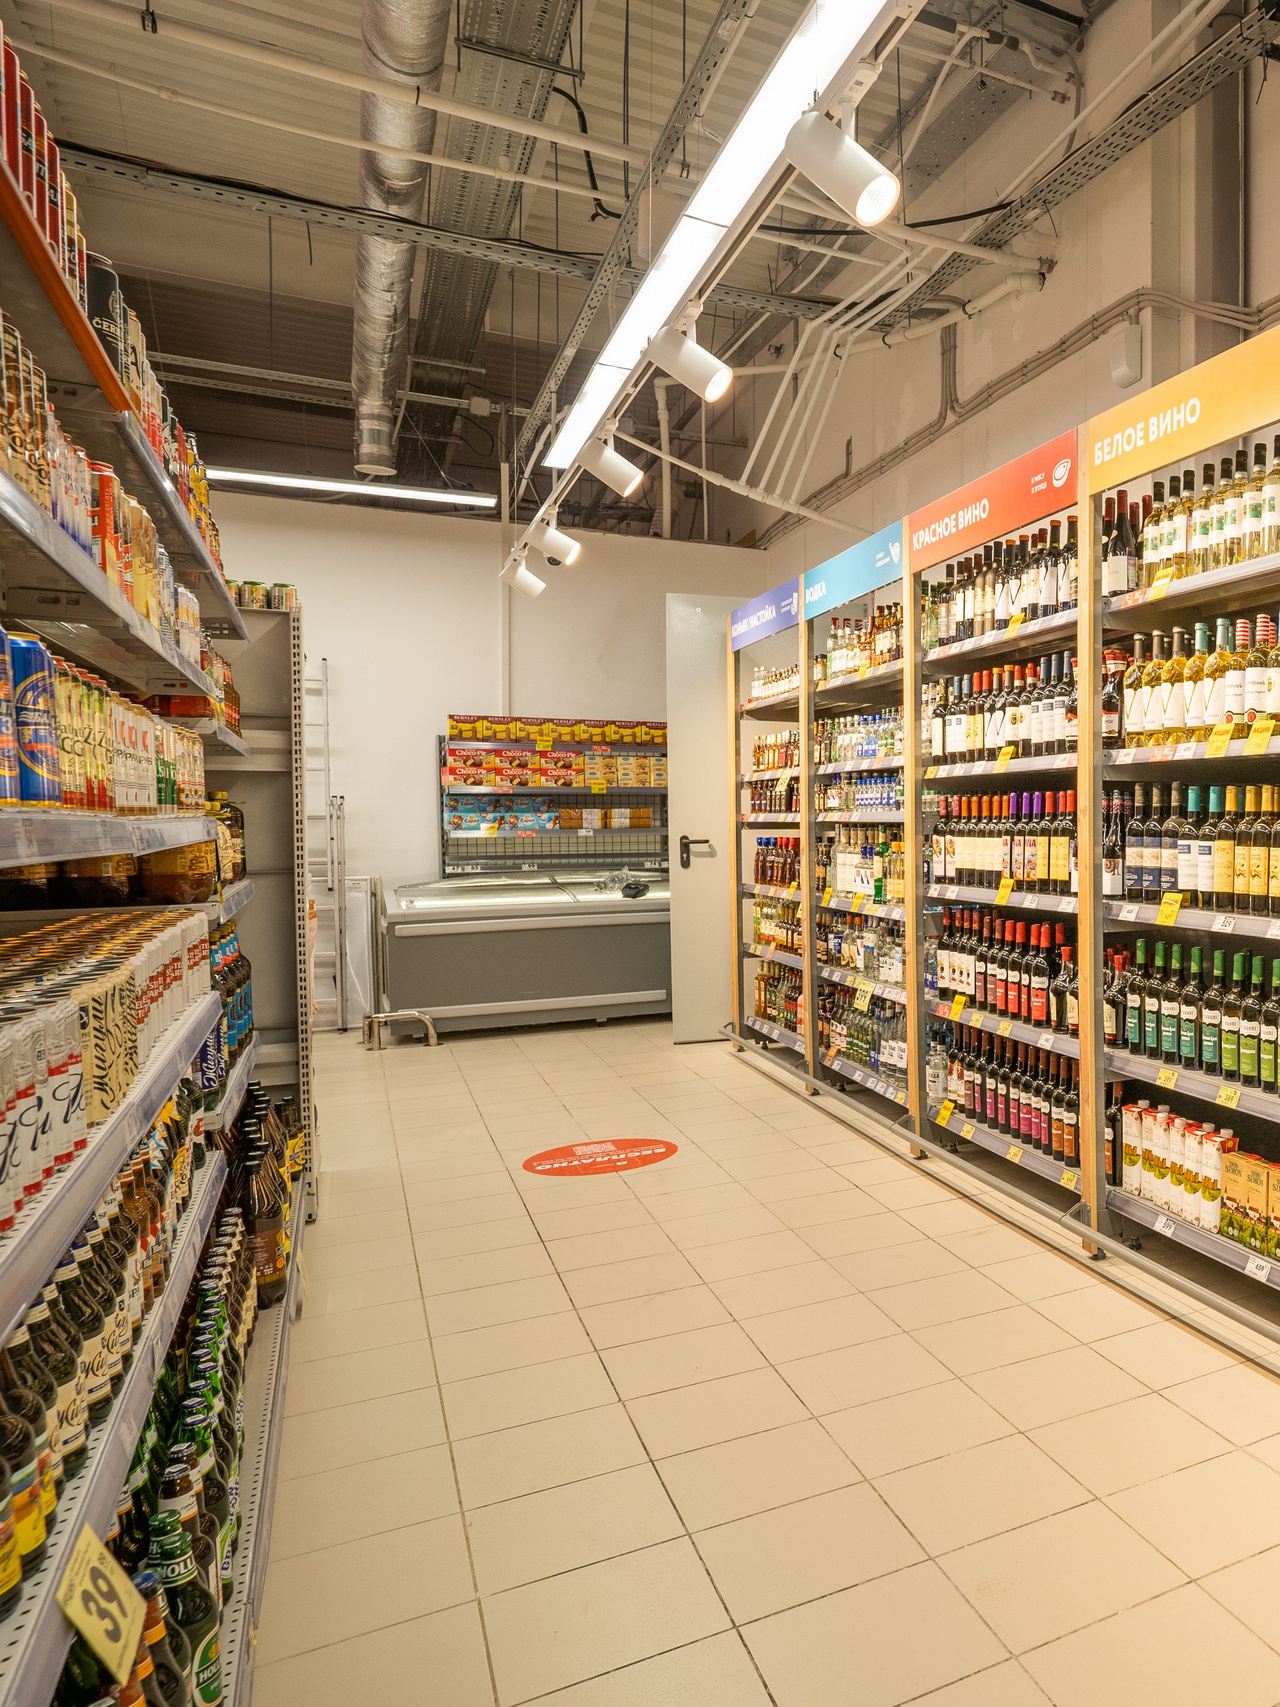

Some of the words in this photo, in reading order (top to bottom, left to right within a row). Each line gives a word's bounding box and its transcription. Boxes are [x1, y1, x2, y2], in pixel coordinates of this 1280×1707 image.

[1094, 422, 1145, 466] БЕЛОЕ
[1149, 397, 1201, 443] ВИНО
[1034, 472, 1045, 483] МЯСУ
[912, 513, 957, 551] КРАСНОЕ
[958, 498, 989, 531] ВИНО
[805, 581, 827, 604] ВОДКА
[535, 1147, 666, 1171] БЕСПЛАТНО
[1229, 1161, 1239, 1170] DON
[1225, 1165, 1242, 1178] SIMON
[1247, 1174, 1264, 1187] SIMON
[1251, 1170, 1261, 1178] DON
[81, 1566, 128, 1644] 39
